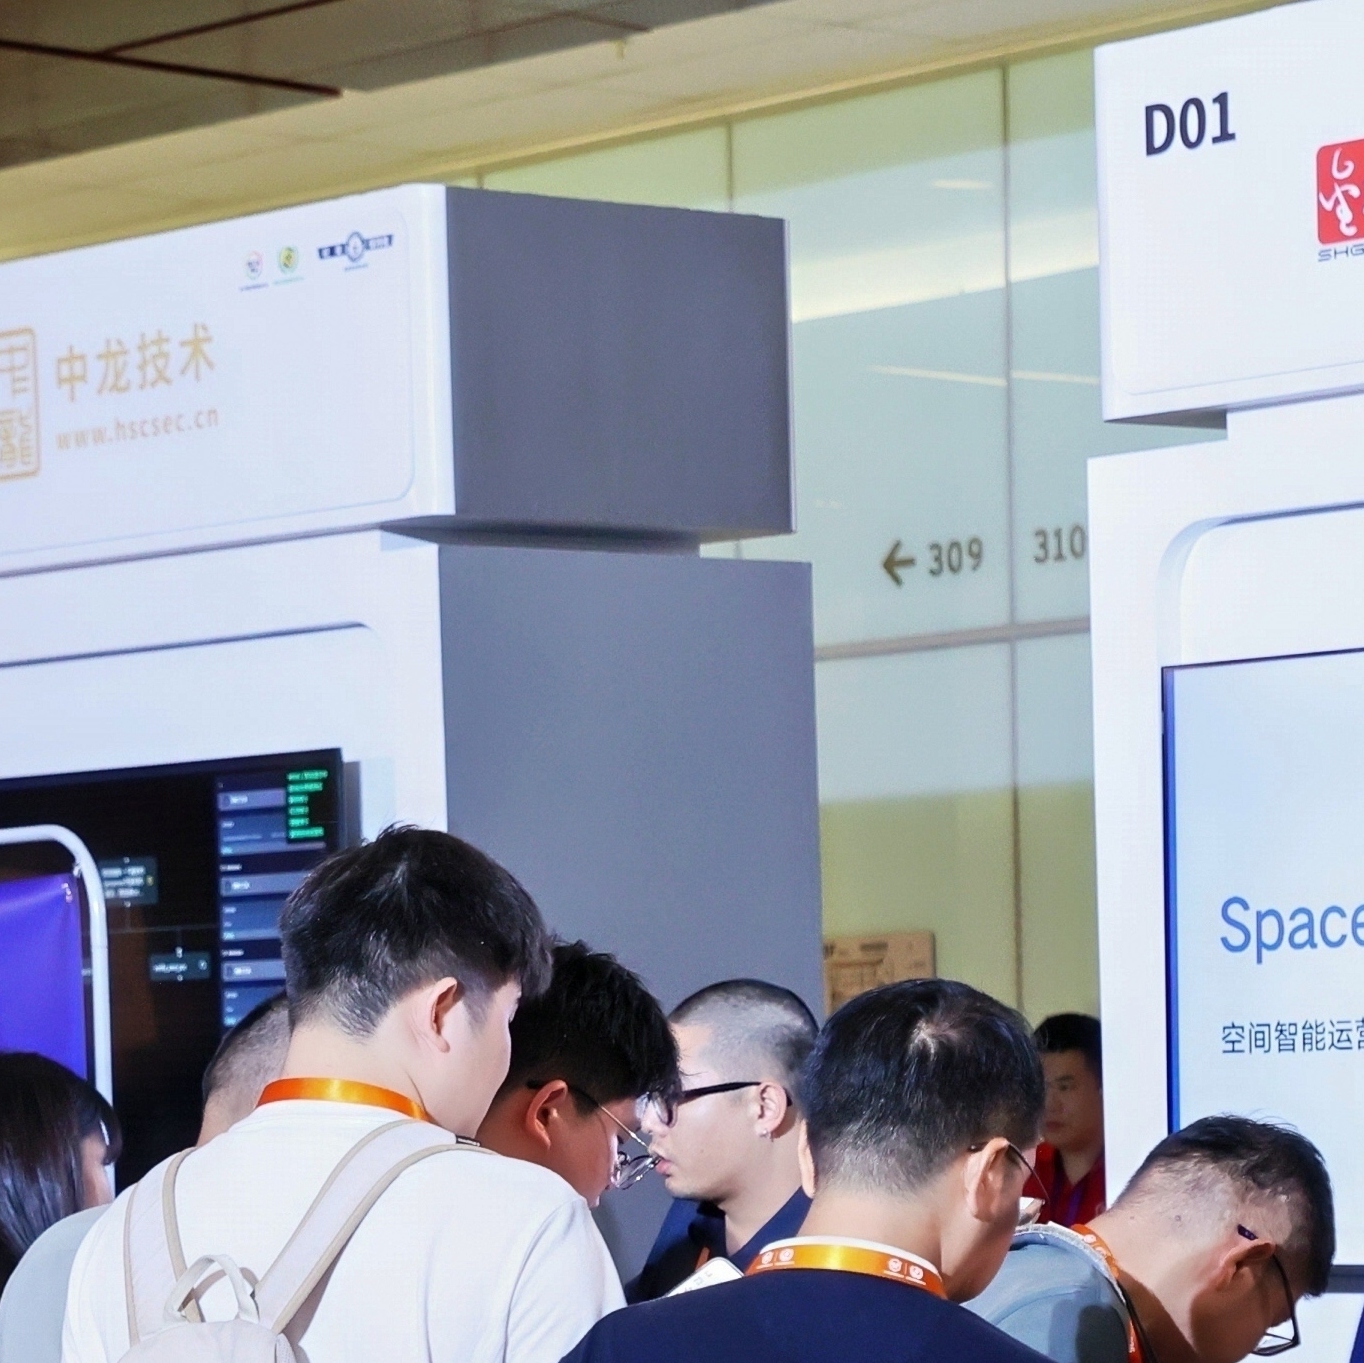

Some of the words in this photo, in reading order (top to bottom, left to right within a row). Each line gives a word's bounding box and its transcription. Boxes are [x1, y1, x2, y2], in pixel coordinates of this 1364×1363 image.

[1142, 90, 1237, 157] D01
[56, 322, 216, 403] 中龙技术
[55, 406, 219, 451] www.hscsec.cn
[928, 537, 984, 577] 309
[1033, 525, 1086, 565] 310
